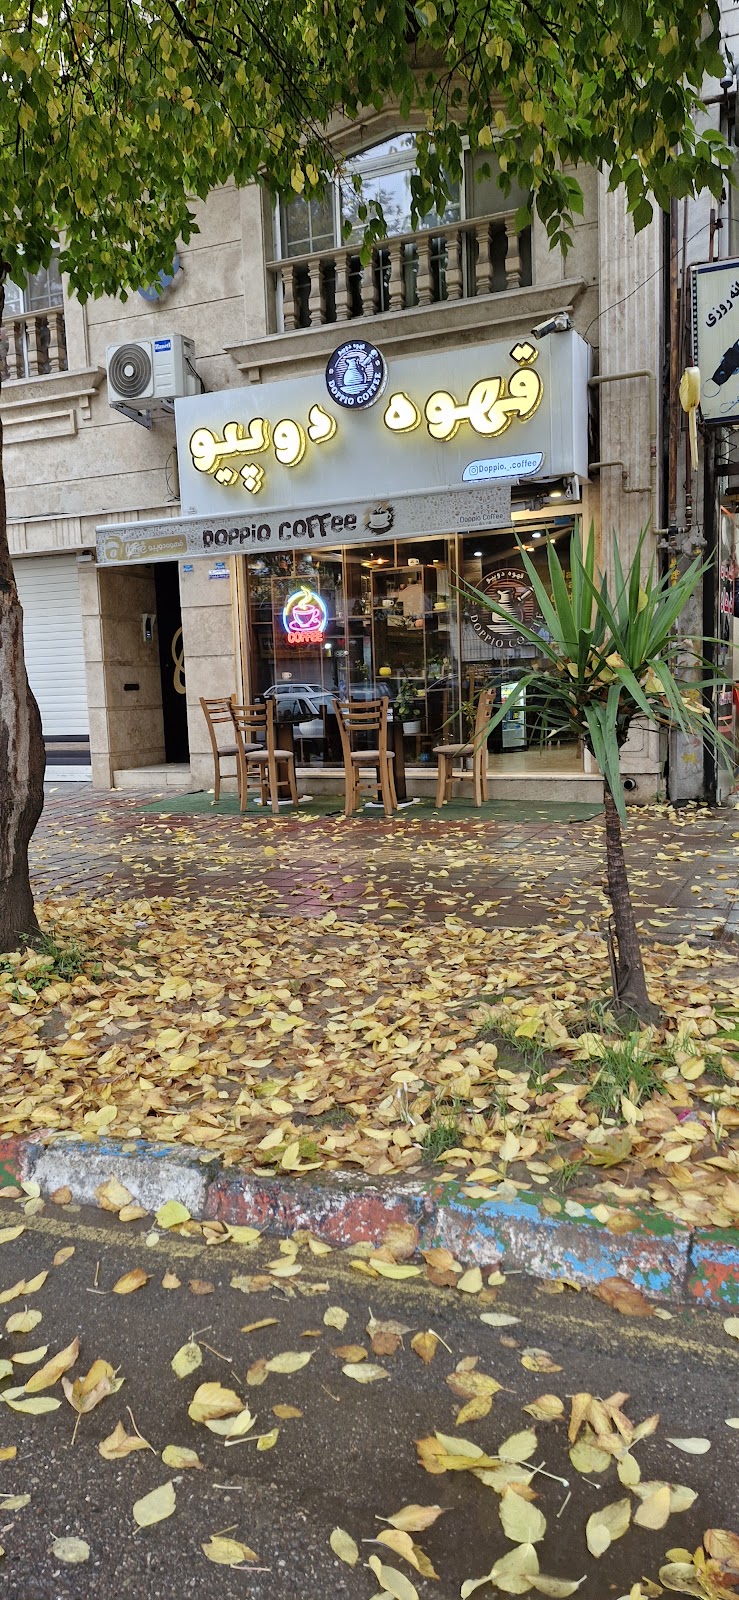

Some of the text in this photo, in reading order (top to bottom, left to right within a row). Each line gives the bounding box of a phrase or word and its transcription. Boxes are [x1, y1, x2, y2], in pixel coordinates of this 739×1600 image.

[705, 299, 734, 328] روزی
[328, 372, 382, 405] DOPPIO COFFEE
[189, 341, 544, 495] قهوه دوپیو
[459, 513, 504, 524] Doppio Coffee
[507, 571, 525, 580] قهوه
[287, 630, 324, 644] COFFEE
[470, 614, 504, 648] DOPPIO
